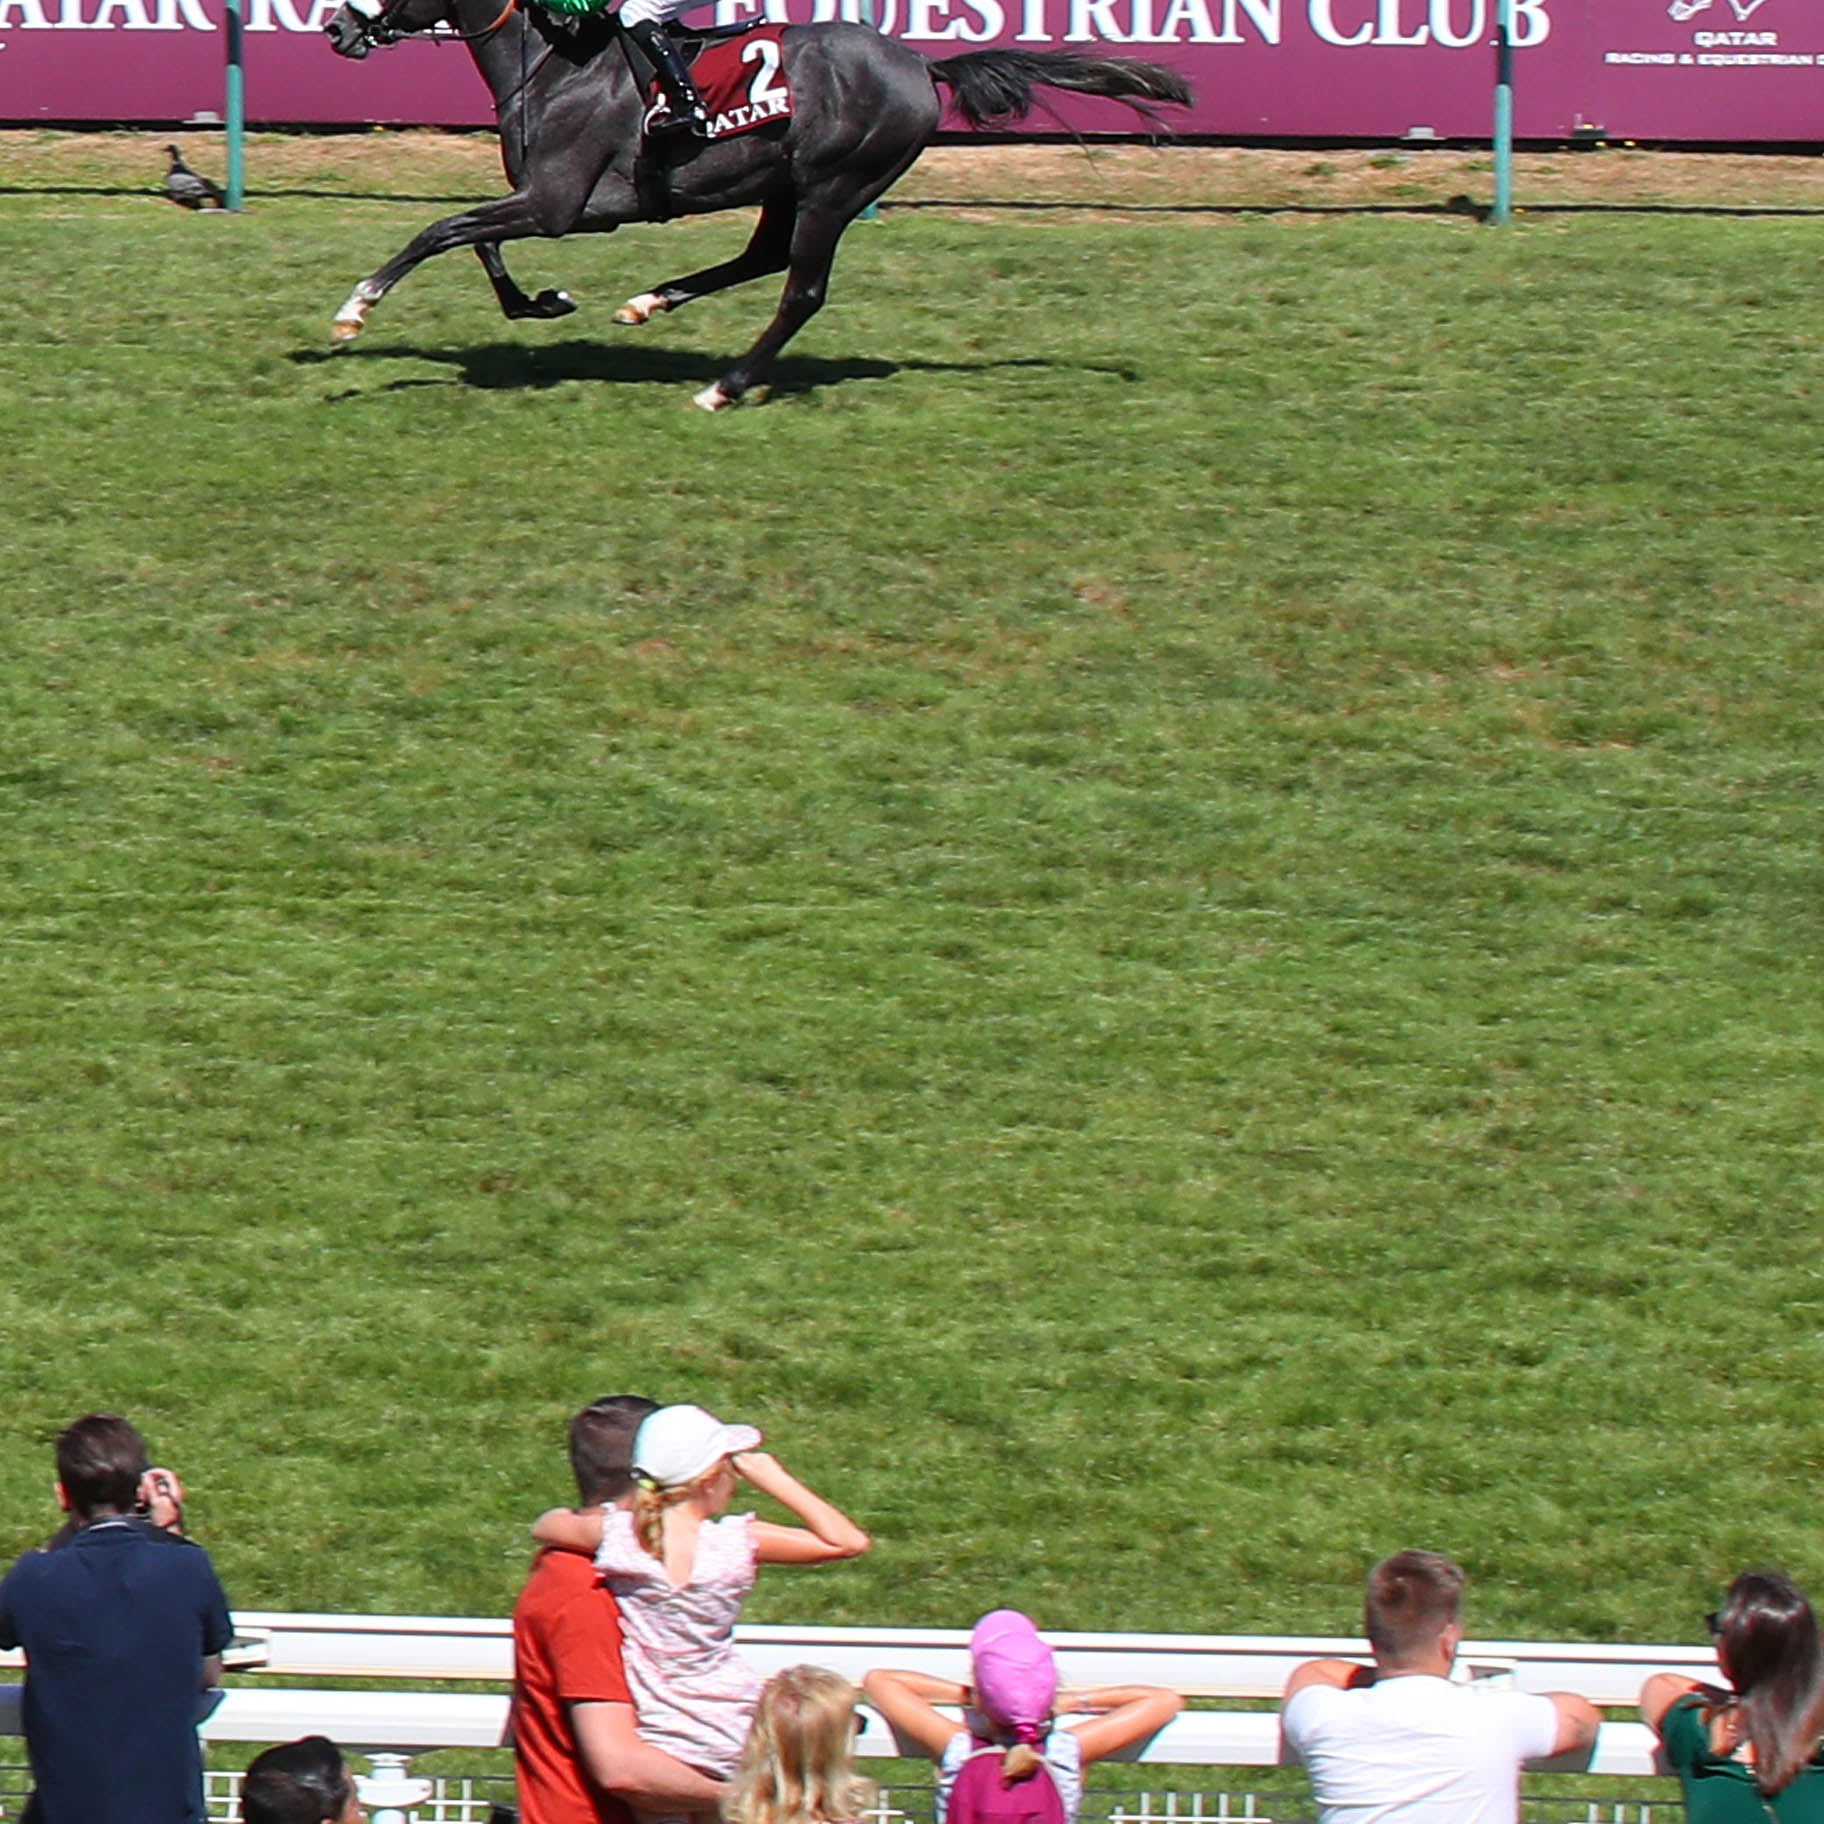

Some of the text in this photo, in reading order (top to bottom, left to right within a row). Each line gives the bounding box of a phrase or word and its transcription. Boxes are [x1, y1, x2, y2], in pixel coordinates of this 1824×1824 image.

[1693, 31, 1779, 48] QATAR
[1605, 52, 1676, 64] RACING
[1696, 54, 1814, 66] EQUESTRIAN
[742, 39, 789, 104] 2
